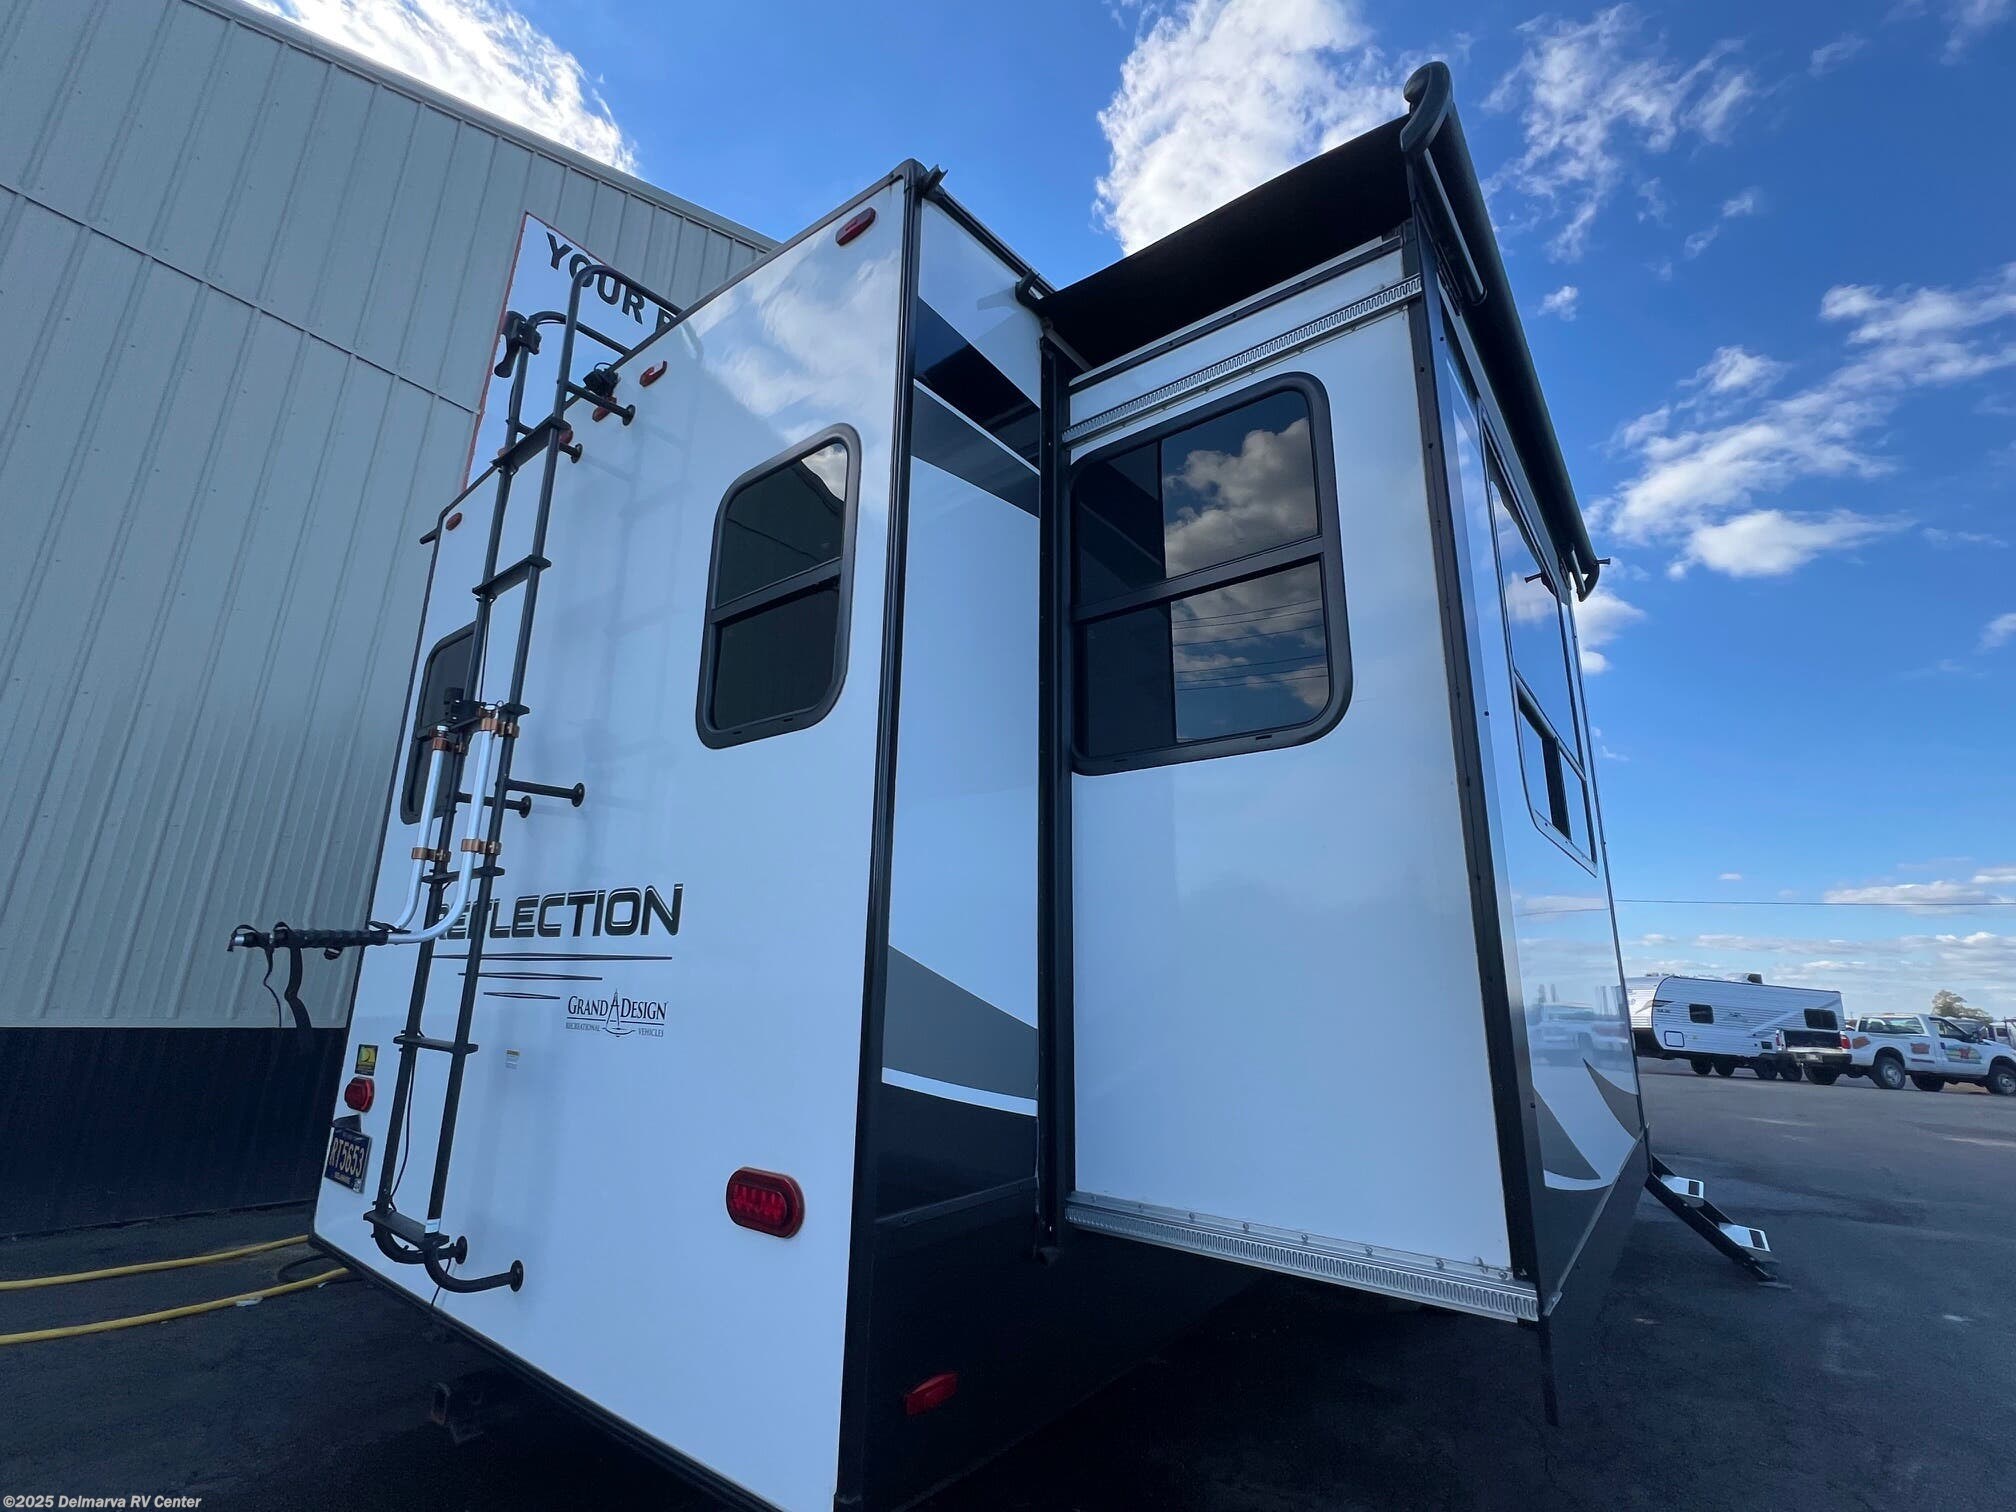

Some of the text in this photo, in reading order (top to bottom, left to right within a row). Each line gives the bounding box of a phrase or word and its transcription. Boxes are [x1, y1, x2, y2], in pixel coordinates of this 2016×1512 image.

[546, 232, 645, 325] YOUR
[568, 995, 667, 1020] GRAND DESIGN
